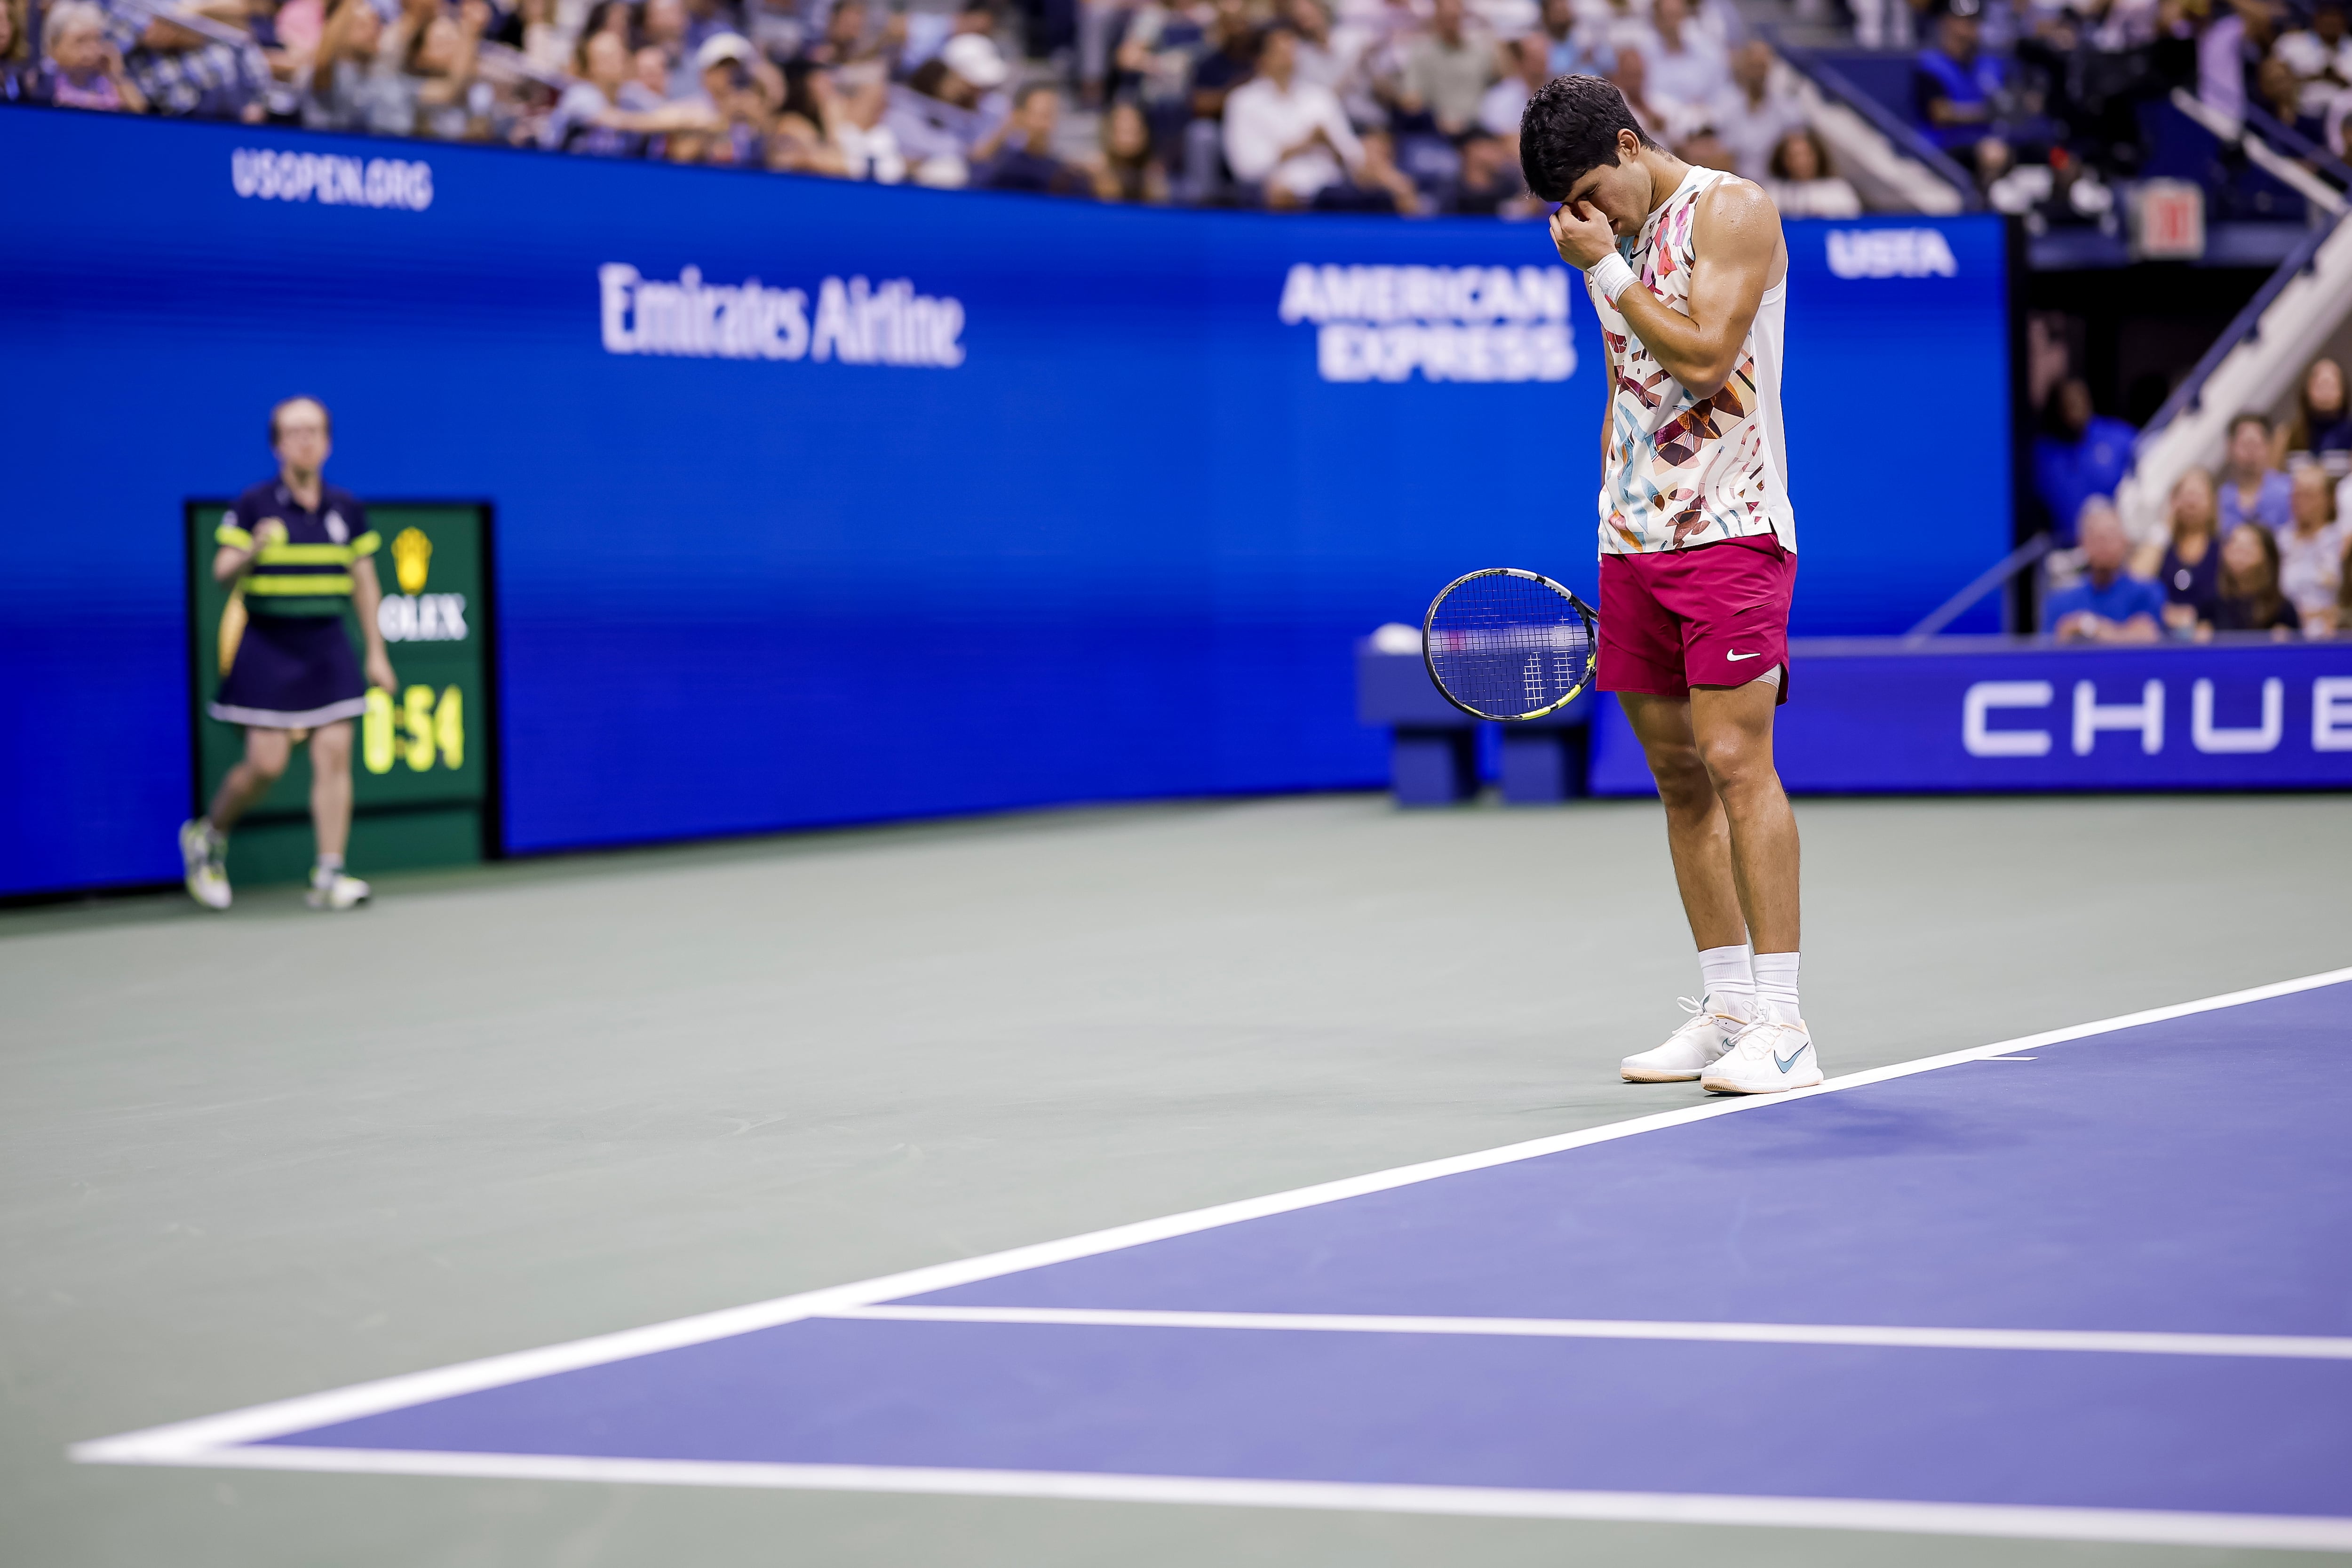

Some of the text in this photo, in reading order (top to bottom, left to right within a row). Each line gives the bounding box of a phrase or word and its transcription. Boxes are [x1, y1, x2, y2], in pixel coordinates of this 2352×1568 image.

[232, 150, 433, 210] USOPEN.ORG
[1826, 229, 1955, 278] USTA
[599, 263, 965, 367] Emirates Airline
[1279, 264, 1571, 324] AMERICAN
[1318, 325, 1577, 382] EXPRESS
[378, 594, 468, 642] OLEX
[363, 682, 464, 774] 0:54
